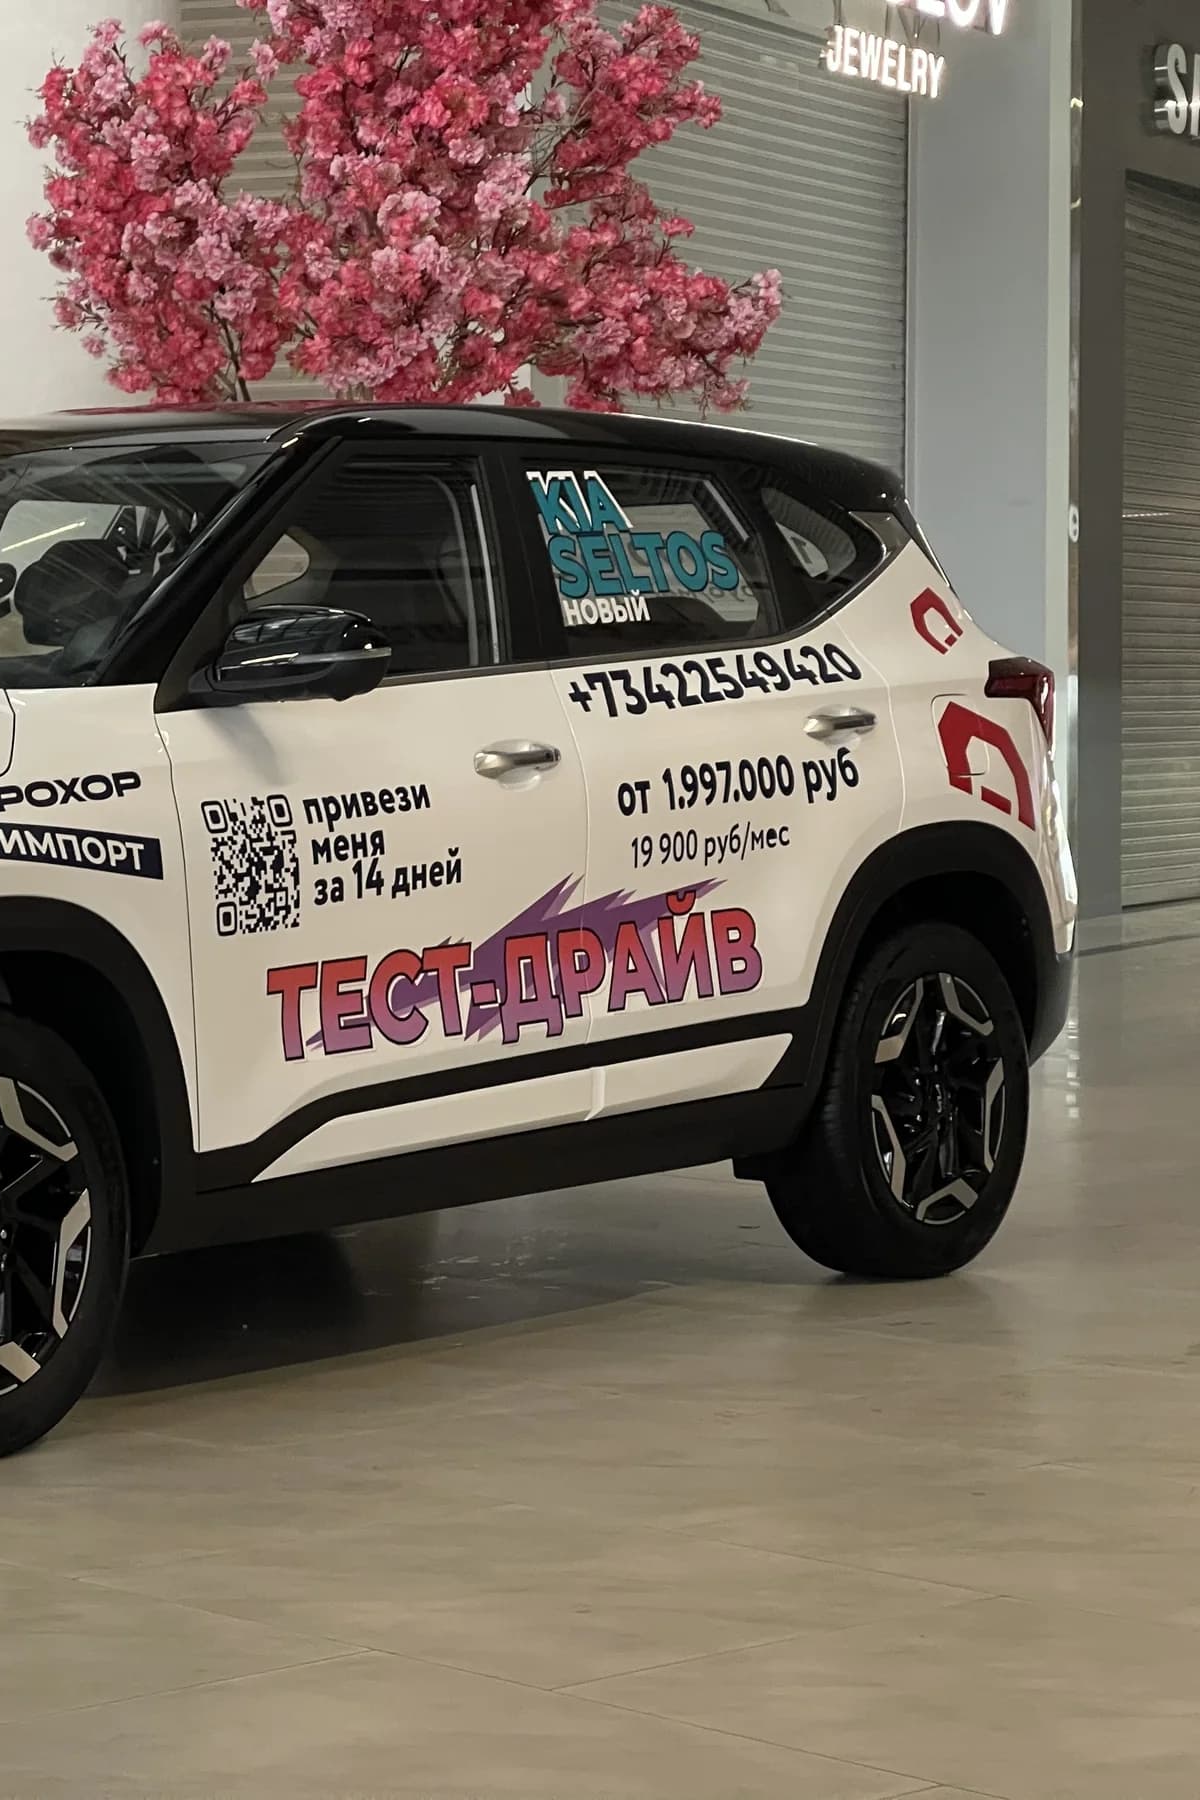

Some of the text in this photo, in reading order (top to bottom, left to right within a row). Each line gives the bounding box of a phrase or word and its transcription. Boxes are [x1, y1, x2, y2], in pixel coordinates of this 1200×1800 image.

[826, 25, 945, 98] JEWELRY
[526, 470, 634, 536] KIA
[548, 530, 740, 598] SELTOS
[562, 589, 650, 627] НОВЫЙ
[568, 642, 862, 718] +73422549420
[303, 784, 432, 832] привези
[617, 747, 860, 817] от 1.997.000 руб
[311, 827, 385, 866] меня
[313, 848, 462, 906] за 14 дней
[630, 822, 791, 868] 19 900 руб/мес
[266, 890, 763, 1062] ТЕСТ-ДРАЙВ
